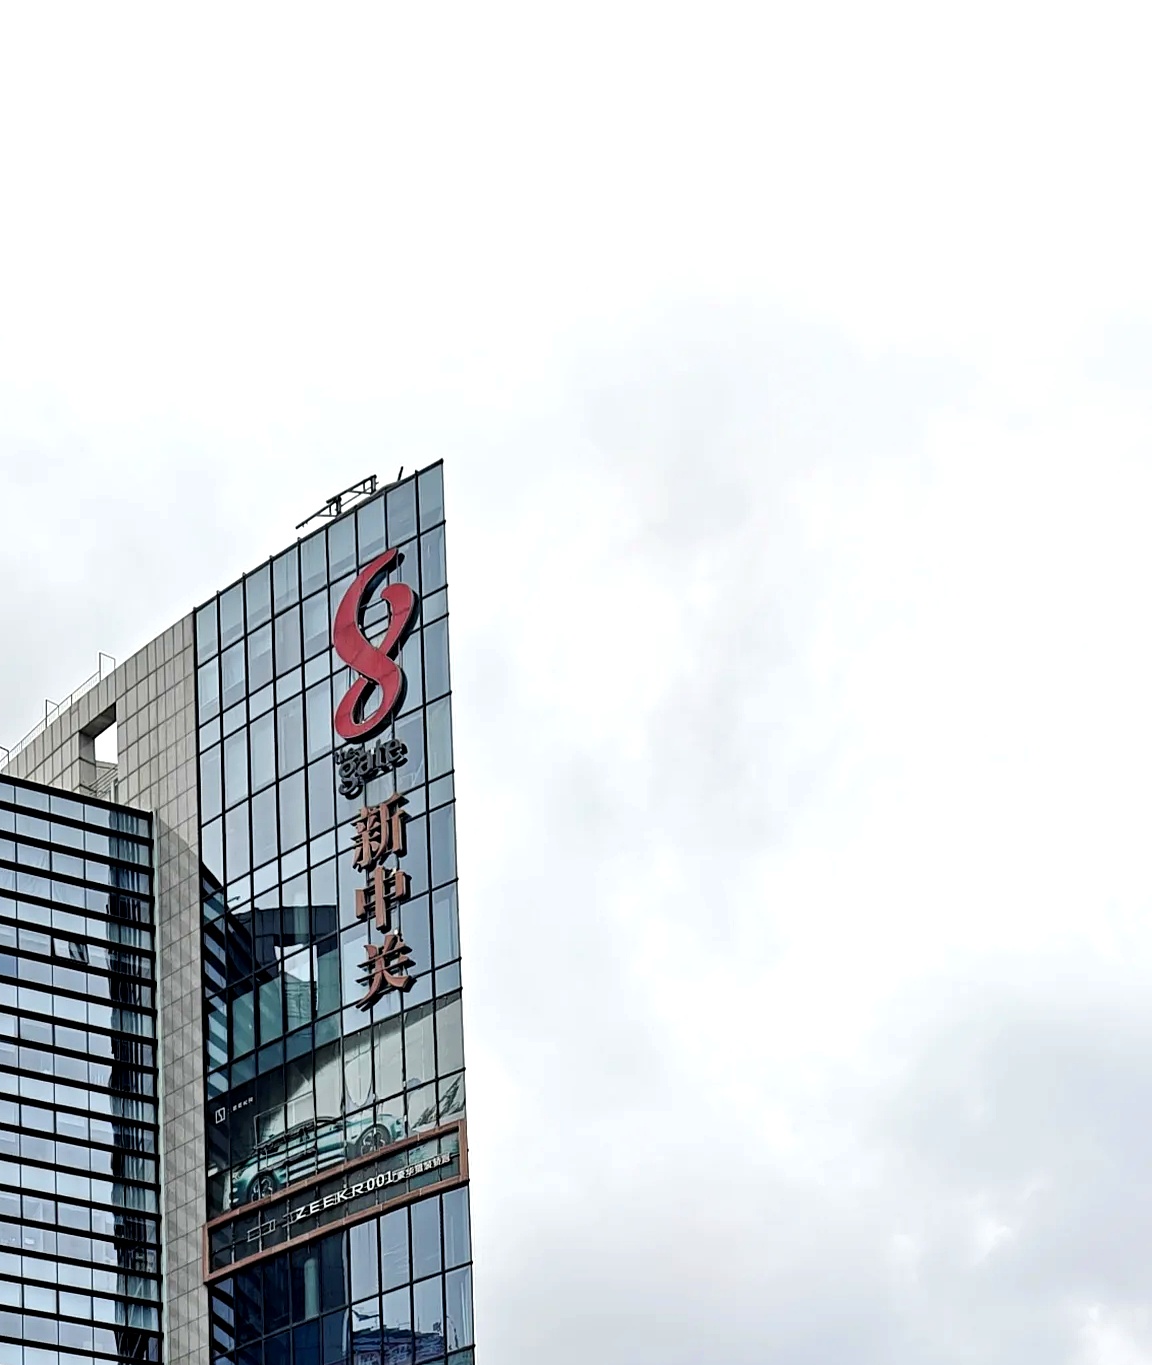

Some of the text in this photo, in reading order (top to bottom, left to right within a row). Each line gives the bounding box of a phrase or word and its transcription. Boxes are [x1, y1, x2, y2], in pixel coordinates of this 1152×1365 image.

[338, 739, 404, 796] gate
[349, 792, 414, 1010] 新中关
